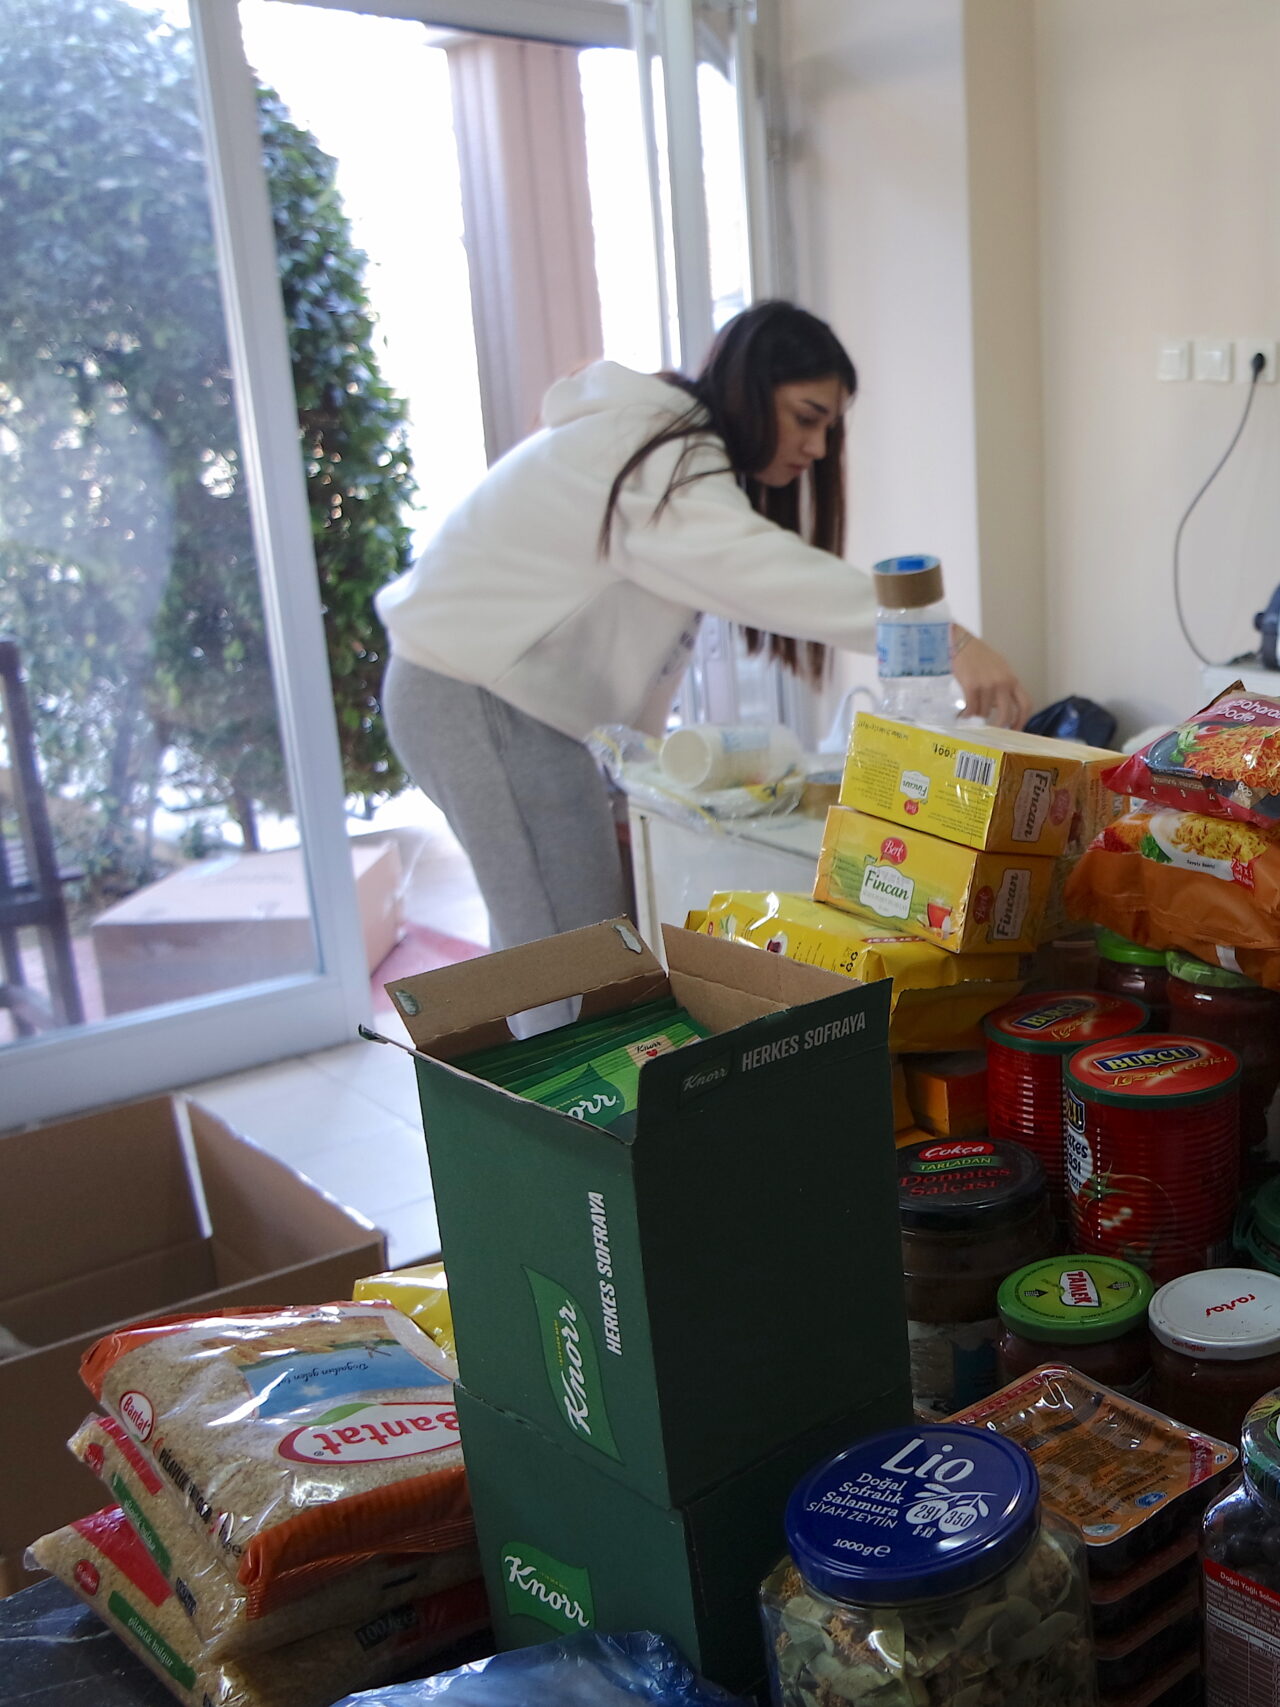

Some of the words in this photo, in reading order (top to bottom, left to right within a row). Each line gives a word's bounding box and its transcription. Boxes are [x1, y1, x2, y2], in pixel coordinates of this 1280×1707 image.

[865, 869, 909, 900] Fincan
[634, 1039, 662, 1053] Knorr
[741, 1034, 800, 1073] HERKES
[803, 1011, 867, 1050] SOFRAYA
[1107, 1049, 1189, 1070] BURCU
[682, 1066, 729, 1092] Knorr
[566, 1093, 617, 1121] orr
[900, 1168, 1012, 1187] Domates
[920, 1157, 991, 1171] TARLADAN
[587, 1191, 614, 1278] SOFRAYA
[1066, 1271, 1093, 1304] TAMEK
[599, 1279, 623, 1356] HERKES
[558, 1299, 592, 1436] Knorr
[122, 1395, 150, 1433] Bantat
[312, 1410, 461, 1456] Bantat
[880, 1438, 975, 1483] Lio
[839, 1481, 904, 1505] Sofralık
[856, 1472, 908, 1492] Doğal
[806, 1499, 847, 1518] SİYAH
[851, 1510, 898, 1529] ZEYTİN
[822, 1491, 900, 1518] Salamura
[914, 1504, 942, 1521] 291
[944, 1511, 974, 1527] 350
[504, 1555, 590, 1628] Knorr
[1220, 1571, 1240, 1587] Doğal
[1241, 1582, 1258, 1597] Yağlı
